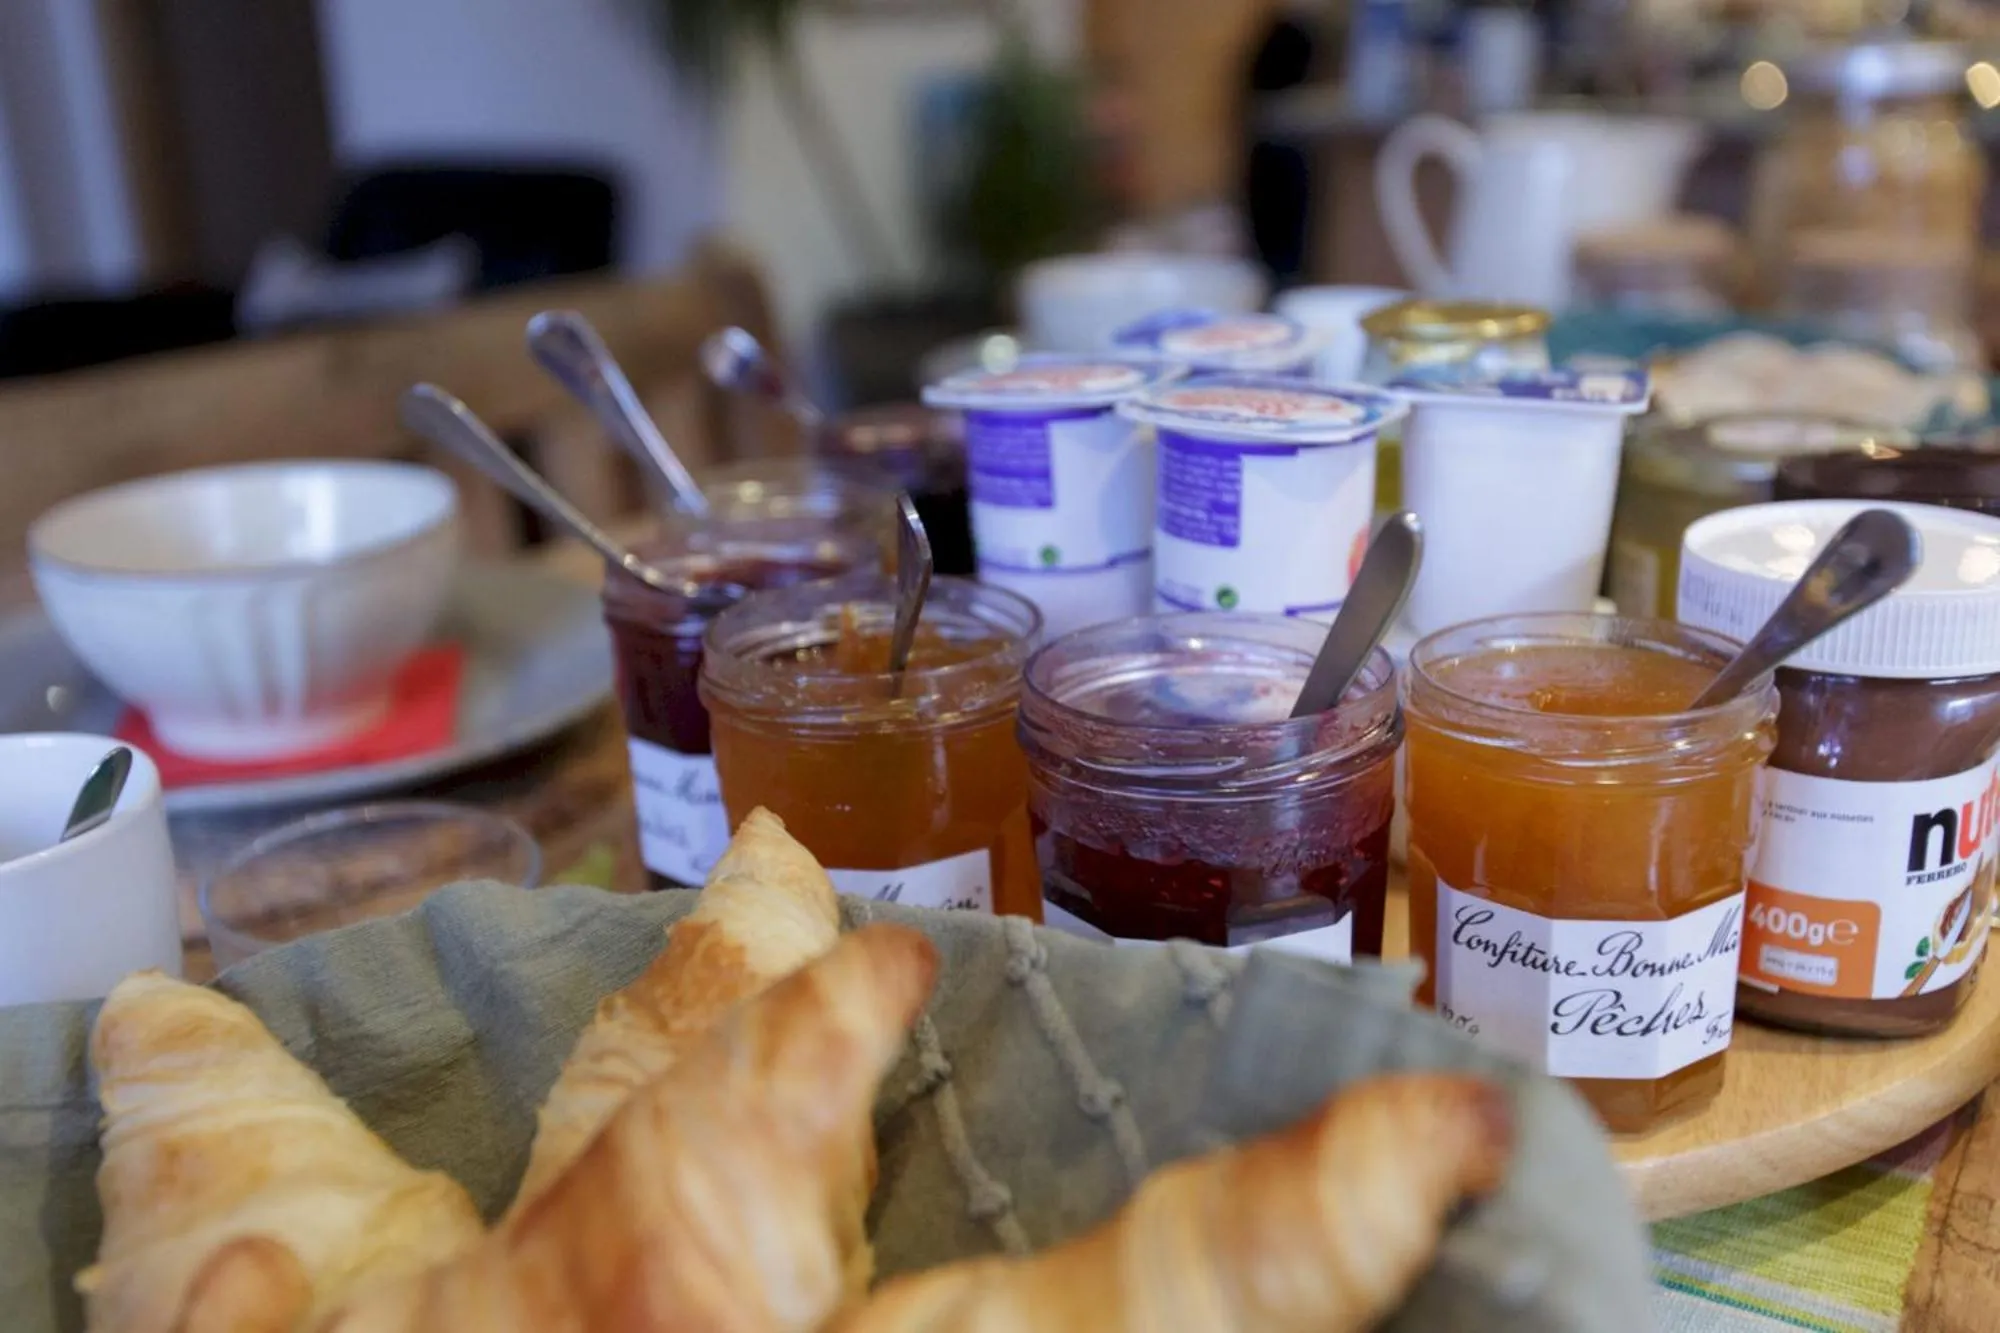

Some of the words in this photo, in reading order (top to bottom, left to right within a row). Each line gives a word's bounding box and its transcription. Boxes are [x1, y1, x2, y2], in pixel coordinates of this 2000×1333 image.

[1906, 861, 1967, 886] FERRERO
[1452, 903, 1587, 977] Confiture
[1591, 930, 1695, 977] Bonne
[1550, 982, 1708, 1038] Pêches
